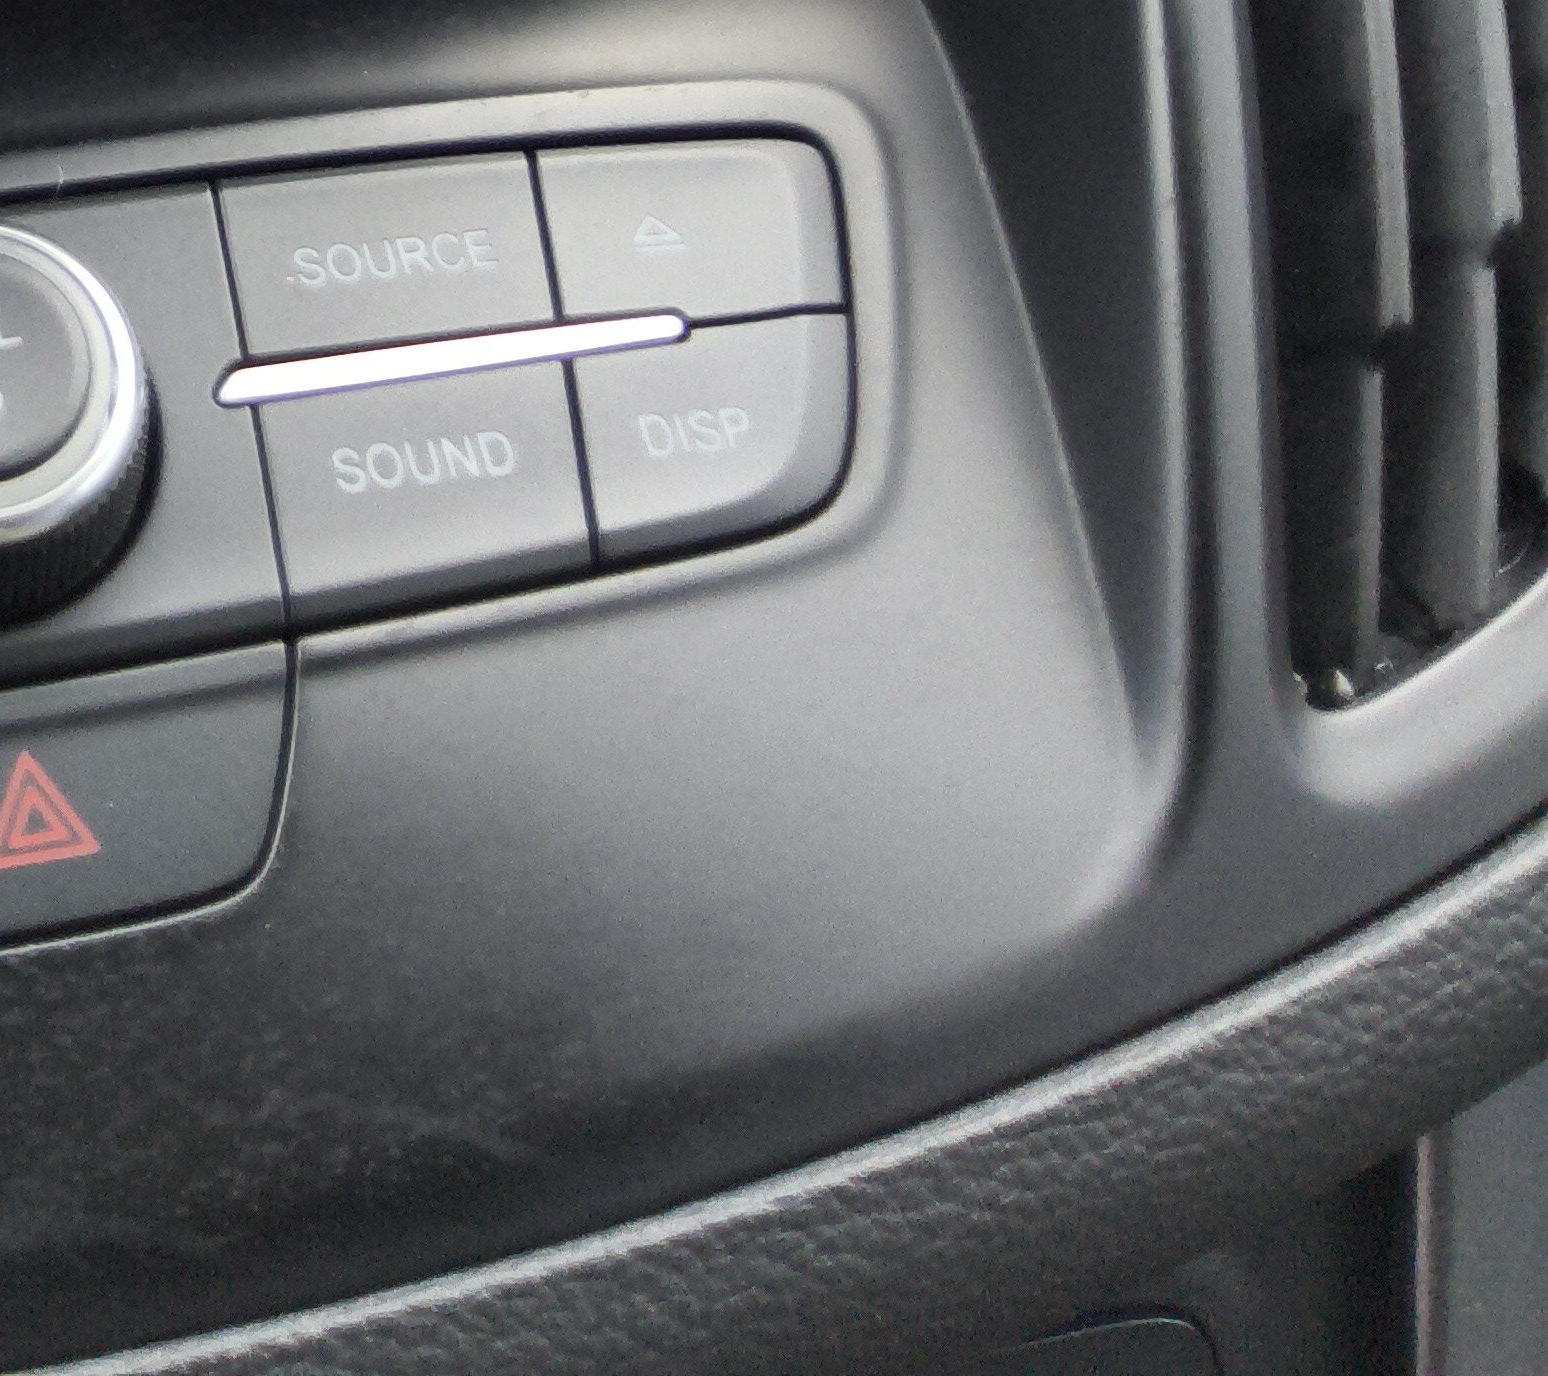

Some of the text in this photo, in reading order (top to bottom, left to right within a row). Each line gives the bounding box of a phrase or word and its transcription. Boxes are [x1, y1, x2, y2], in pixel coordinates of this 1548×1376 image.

[293, 228, 500, 289] SOURCE
[334, 430, 515, 494] SOUND
[639, 407, 751, 461] DISP
